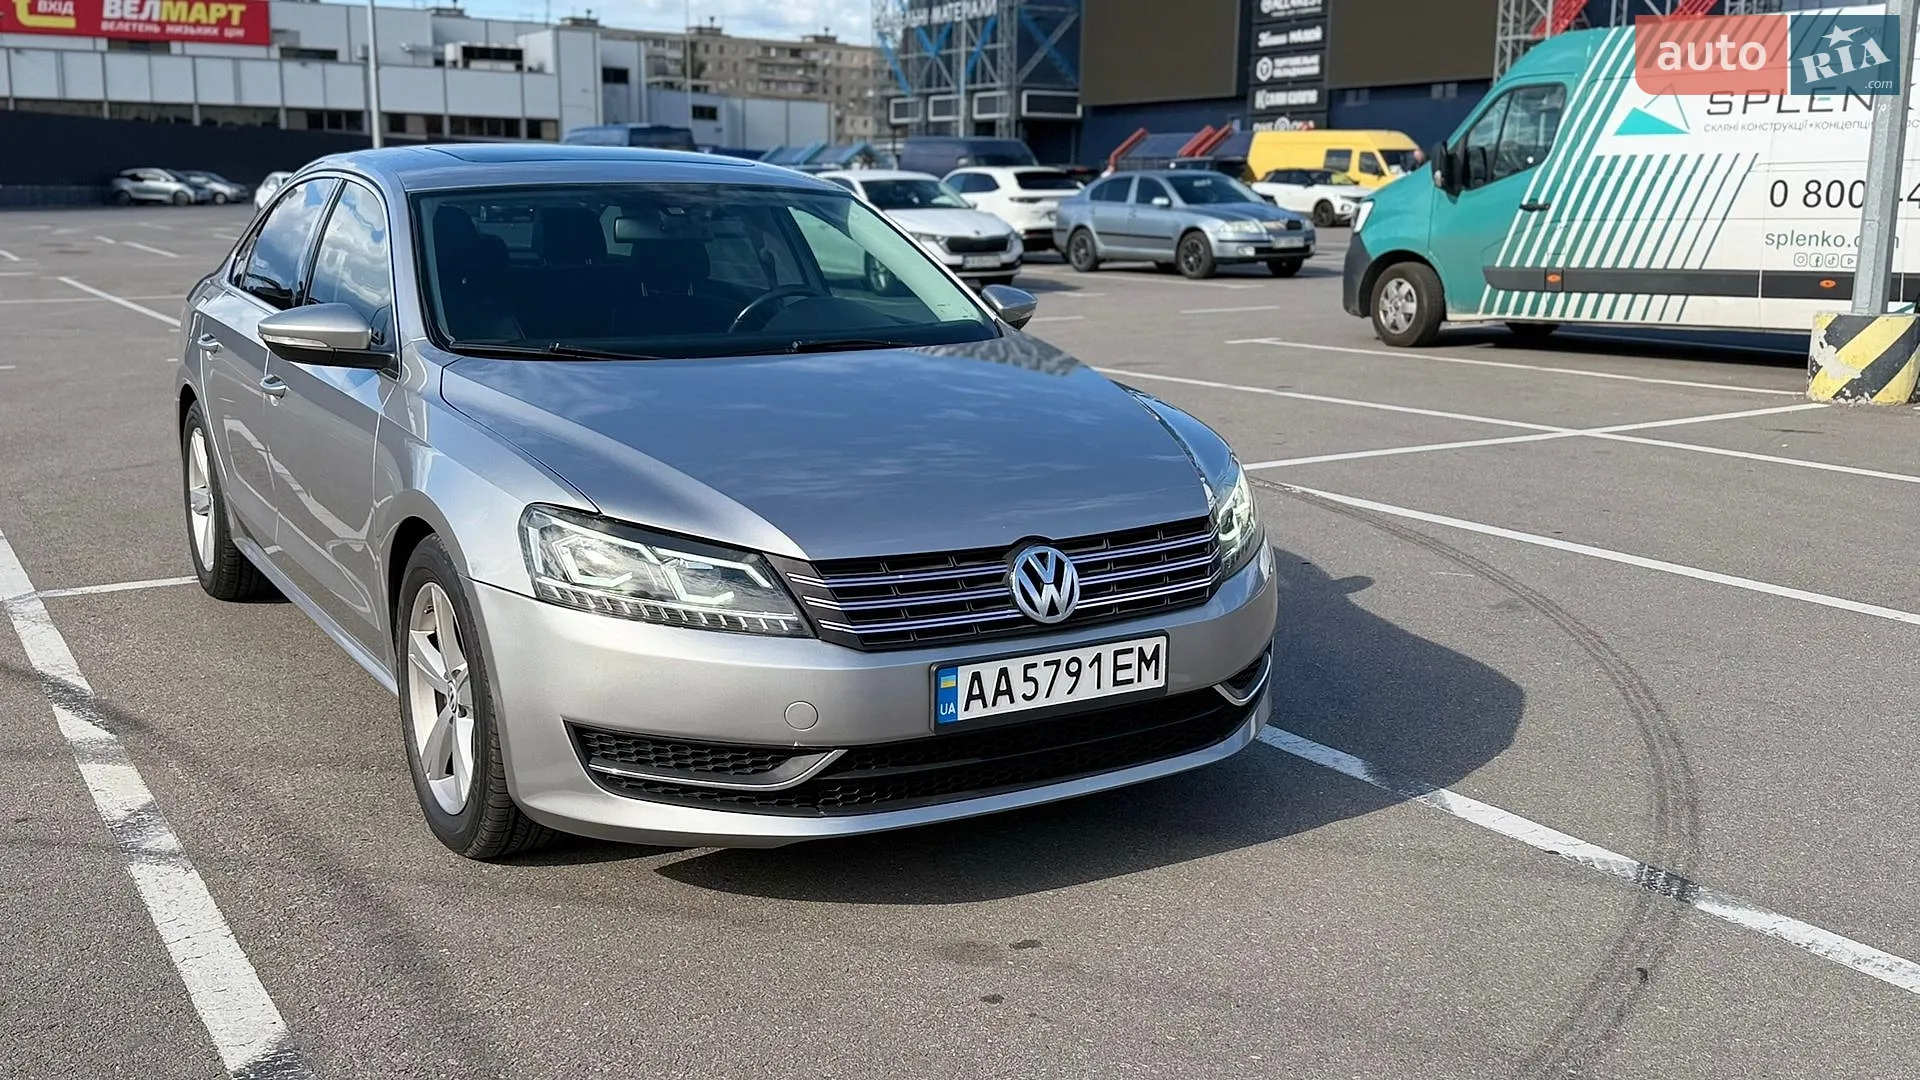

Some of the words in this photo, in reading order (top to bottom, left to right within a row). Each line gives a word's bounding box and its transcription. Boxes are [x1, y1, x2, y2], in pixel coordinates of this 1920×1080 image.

[37, 0, 75, 16] ВХІД
[102, 0, 247, 26] ВЕЛМАРТ
[101, 20, 161, 34] ВЕЛЕТЕНЬ
[166, 23, 219, 36] НИЗЬКИХ
[1706, 84, 1916, 116] SPLEN
[1814, 119, 1875, 131] концепці
[1769, 179, 1789, 208] 0
[963, 643, 1162, 713] AA5791EM
[939, 702, 956, 716] UA
